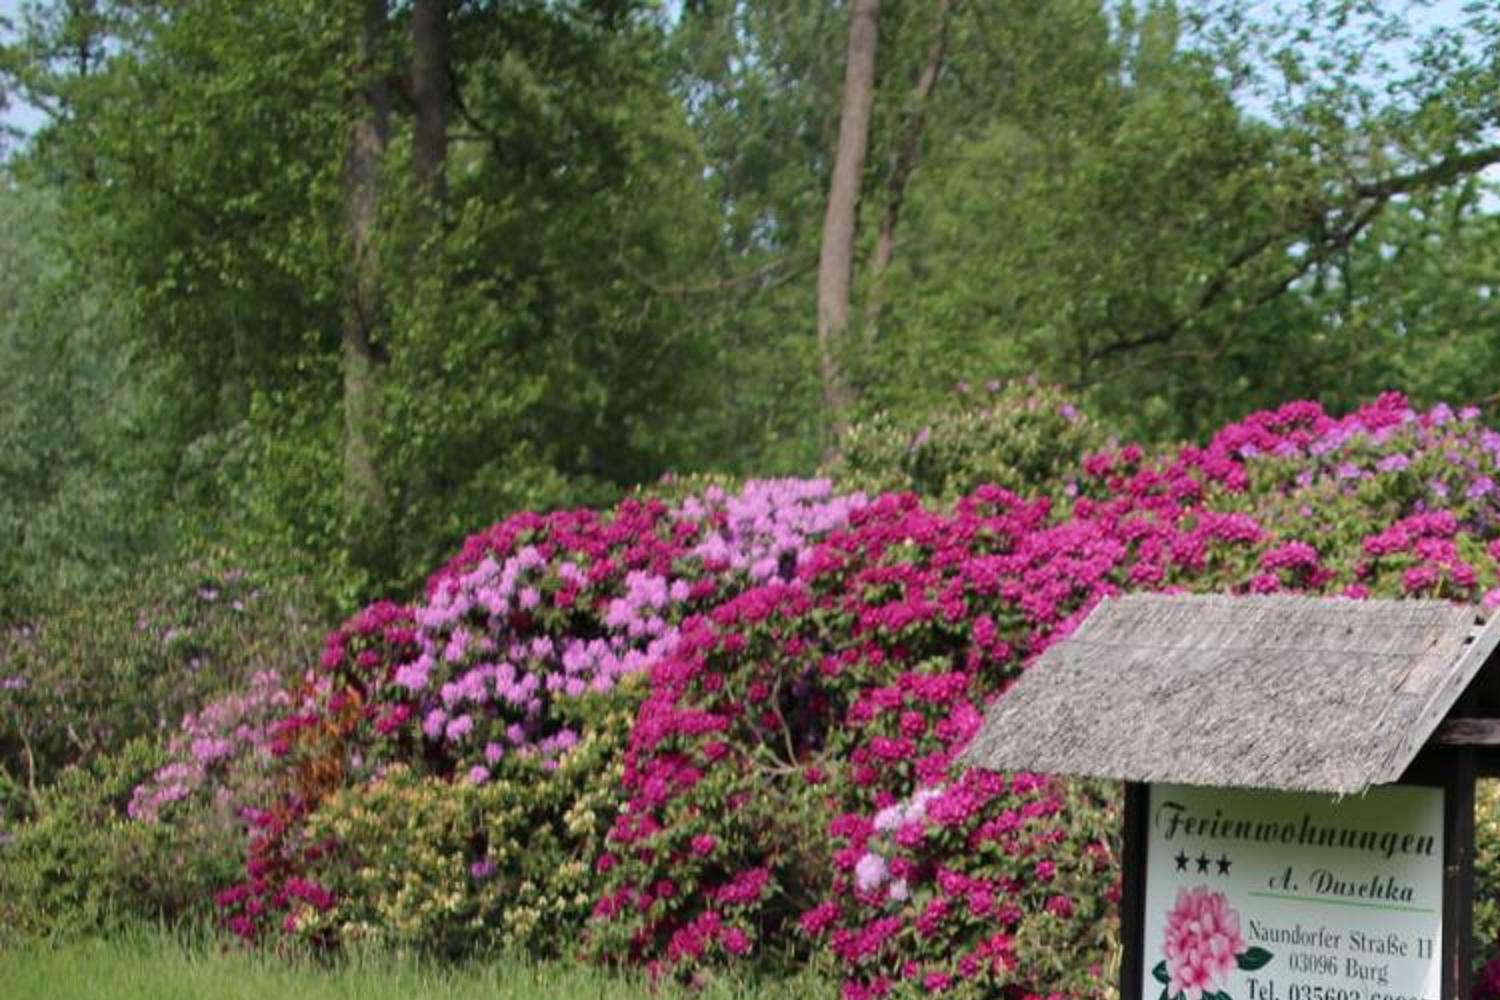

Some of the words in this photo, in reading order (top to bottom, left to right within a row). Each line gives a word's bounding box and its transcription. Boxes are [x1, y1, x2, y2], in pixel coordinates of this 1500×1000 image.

[1155, 801, 1434, 859] Ferienwohnungen
[1268, 866, 1299, 892] A.
[1248, 920, 1341, 948] Naundorfer
[1349, 928, 1407, 957] Straße
[1417, 938, 1433, 960] 11
[1289, 952, 1338, 977] 03096
[1346, 958, 1389, 985] Burg
